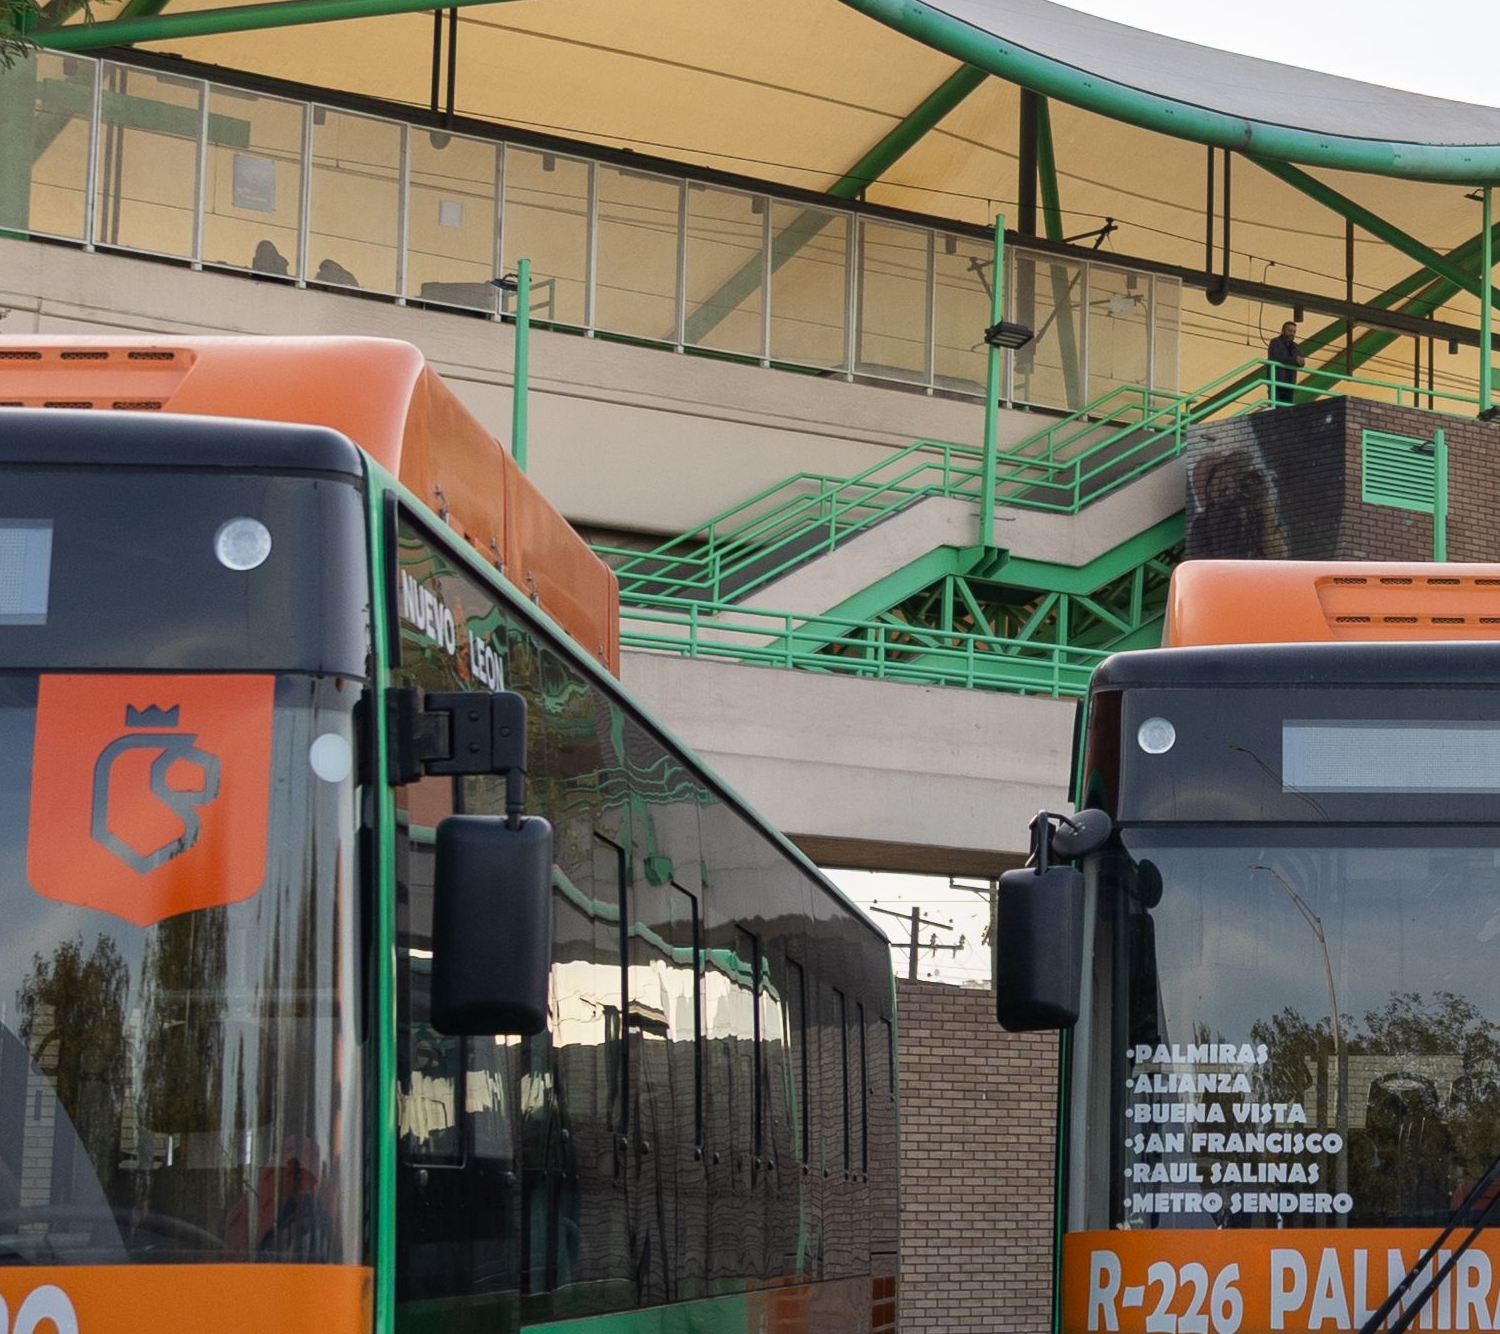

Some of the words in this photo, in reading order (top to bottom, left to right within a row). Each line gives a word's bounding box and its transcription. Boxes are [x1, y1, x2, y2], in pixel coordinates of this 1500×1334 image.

[402, 569, 457, 656] NUEVO
[1135, 1043, 1269, 1065] PALMIRAS
[1133, 1073, 1252, 1094] ALIANZA
[1133, 1103, 1226, 1124] BUENA
[1232, 1103, 1307, 1125] VISTA
[1132, 1132, 1185, 1155] SAN
[1192, 1132, 1344, 1155] FRANCISCO
[1132, 1162, 1203, 1184] RAUL
[1210, 1162, 1320, 1185] SALINAS
[1132, 1192, 1224, 1214] METRO
[1229, 1192, 1354, 1215] SENDERO
